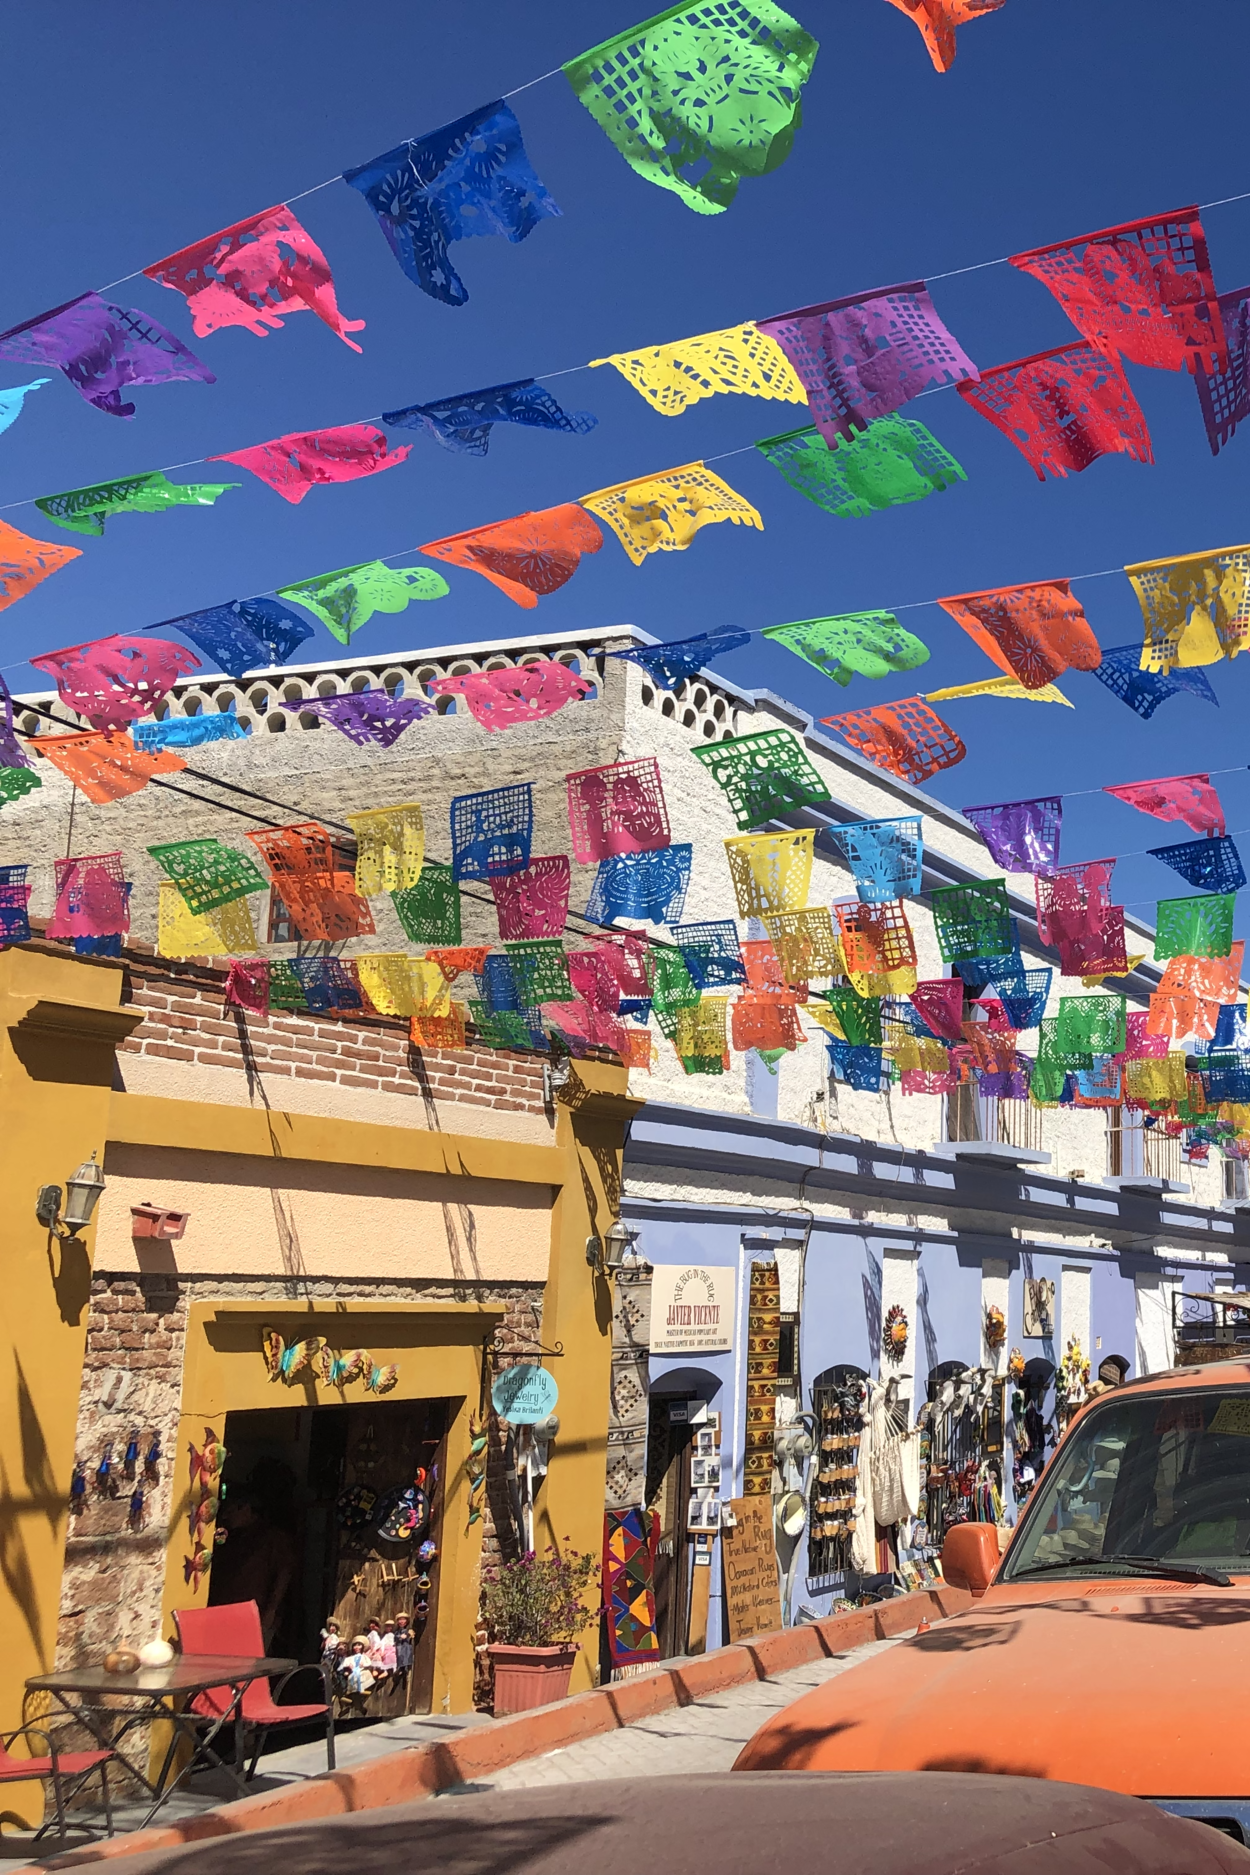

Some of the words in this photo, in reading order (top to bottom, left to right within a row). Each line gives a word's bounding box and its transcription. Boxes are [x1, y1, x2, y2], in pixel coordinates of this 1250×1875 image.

[711, 745, 797, 789] COCO
[674, 1282, 684, 1303] THE
[679, 1269, 693, 1285] BUG
[693, 1269, 699, 1279] IN
[699, 1270, 711, 1284] THE
[706, 1281, 715, 1303] RUG
[666, 1305, 692, 1326] JAVIER
[693, 1305, 721, 1326] VICENTE
[503, 1373, 547, 1390] Dragonfly
[753, 1524, 772, 1555] Rug
[758, 1557, 775, 1579] Rugs
